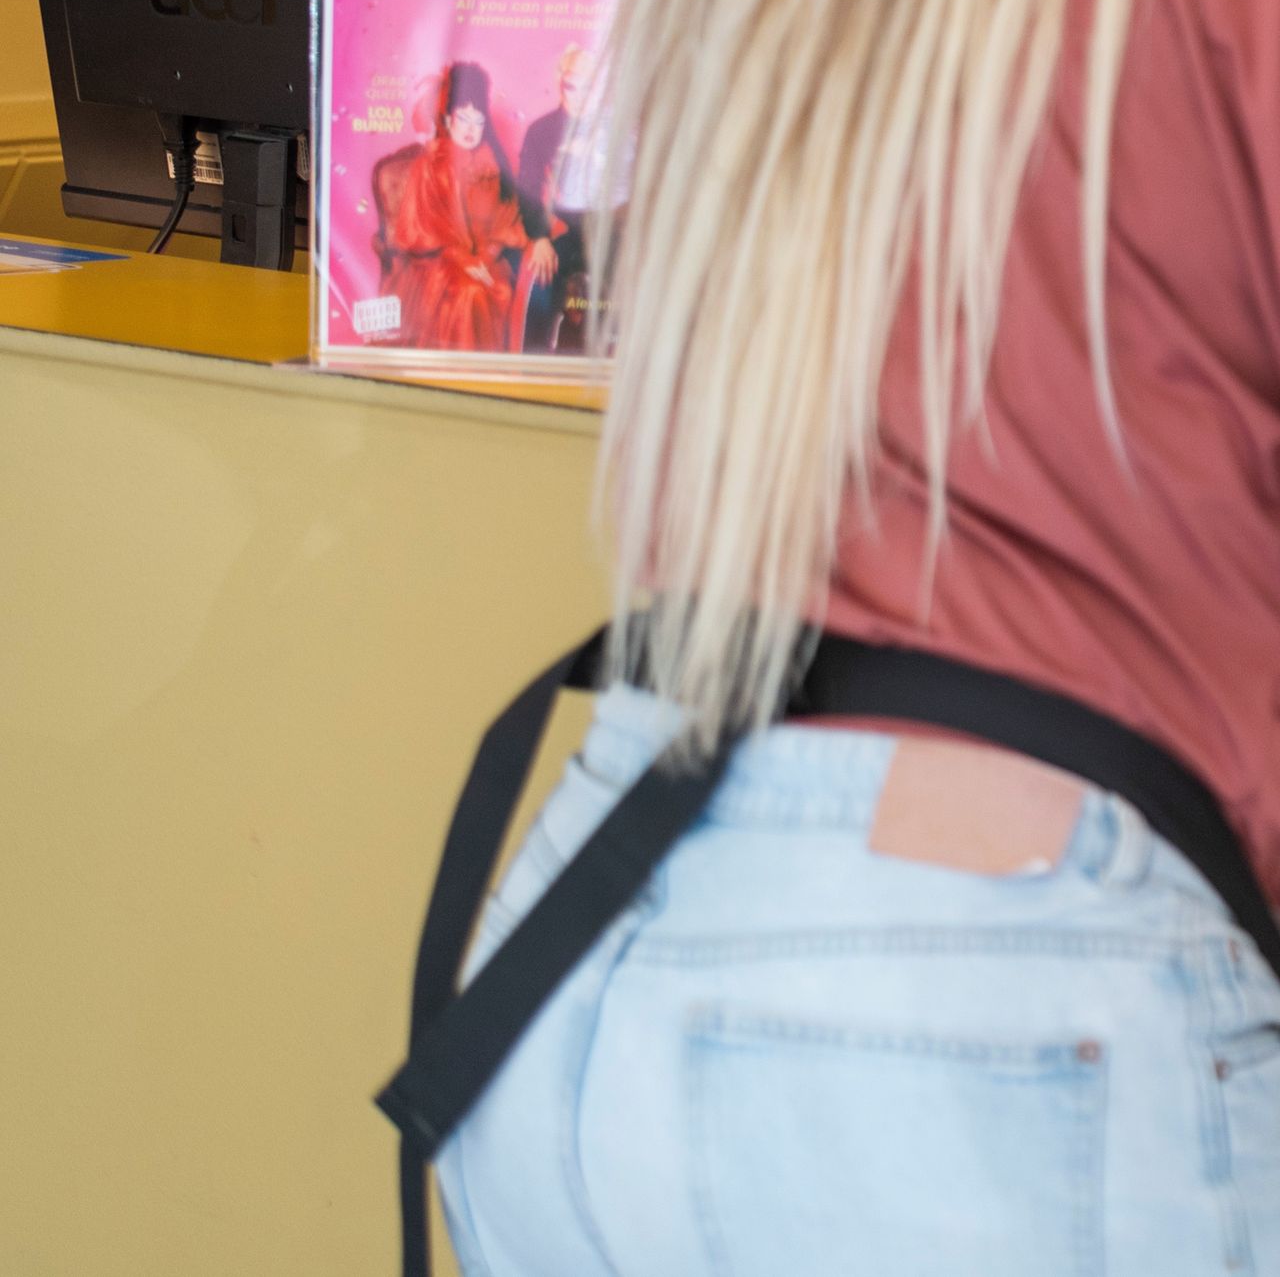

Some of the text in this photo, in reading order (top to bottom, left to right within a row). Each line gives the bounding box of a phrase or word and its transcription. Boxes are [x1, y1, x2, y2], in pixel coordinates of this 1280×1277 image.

[479, 2, 508, 15] you
[368, 105, 404, 119] LOLA
[352, 118, 404, 133] BUNNY
